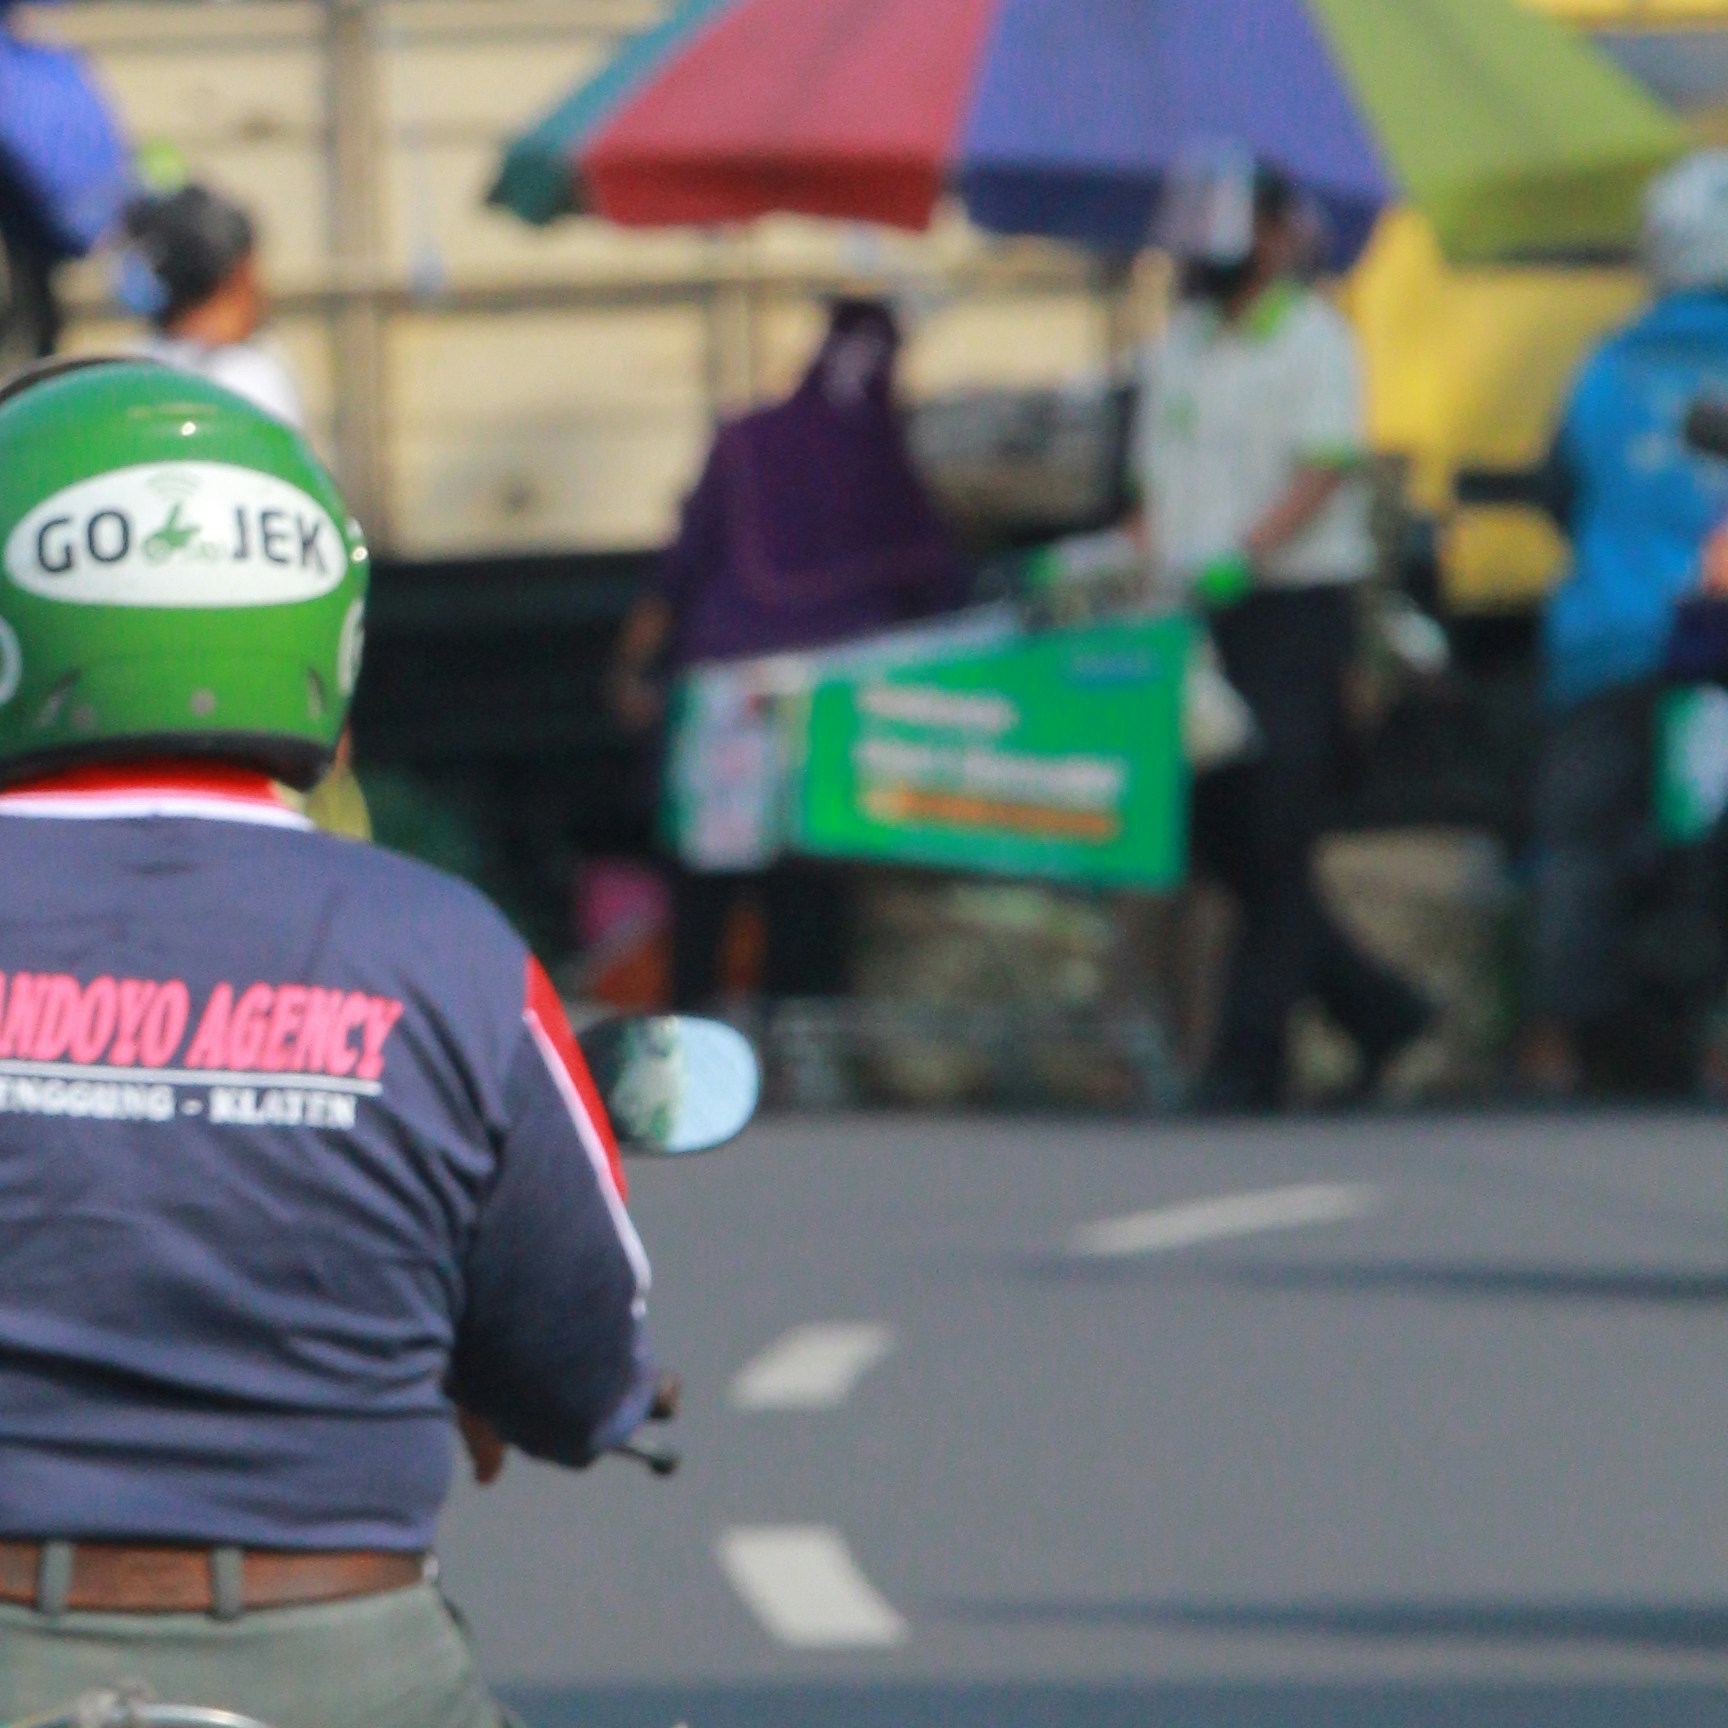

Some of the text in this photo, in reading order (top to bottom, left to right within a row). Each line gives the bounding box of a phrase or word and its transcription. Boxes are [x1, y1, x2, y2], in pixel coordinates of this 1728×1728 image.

[36, 503, 329, 576] GO JEK
[185, 982, 403, 1080] AGENCY
[209, 1086, 357, 1129] KLATEN
